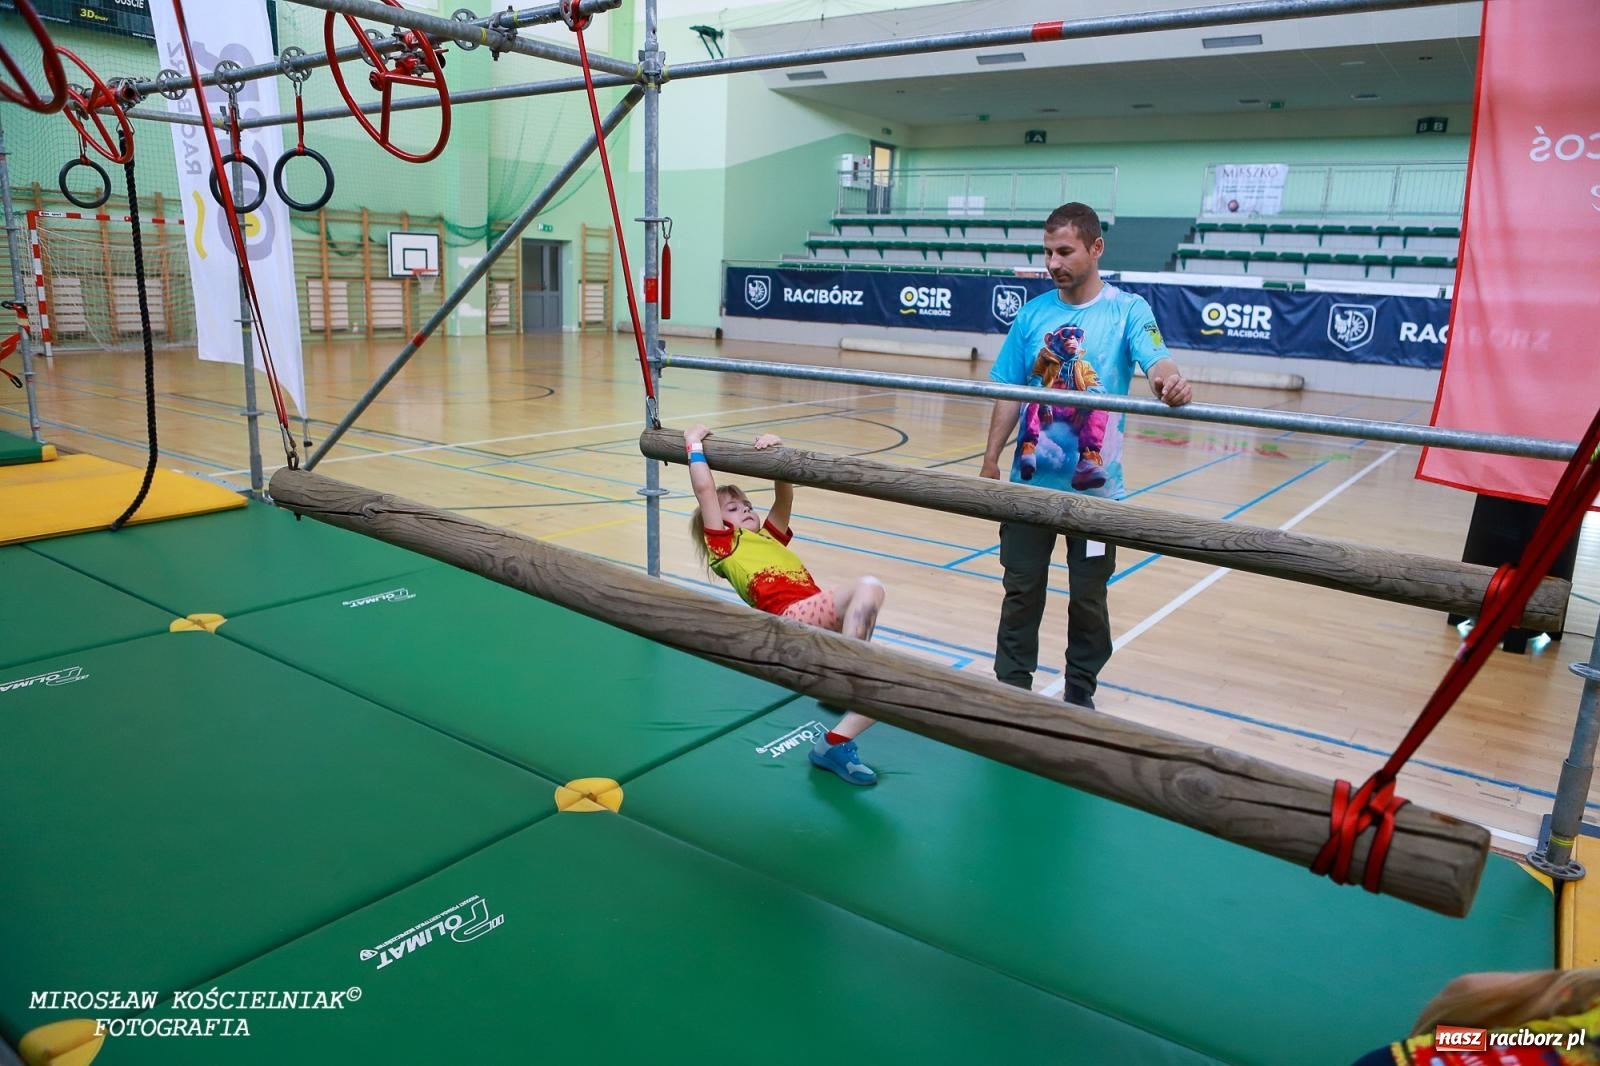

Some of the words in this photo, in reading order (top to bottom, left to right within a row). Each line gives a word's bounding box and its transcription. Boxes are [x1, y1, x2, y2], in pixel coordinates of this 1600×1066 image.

[784, 285, 864, 305] RACIBÓRZ
[919, 308, 951, 316] RACIBÓRZ
[1227, 328, 1271, 339] RACIBÓRZ
